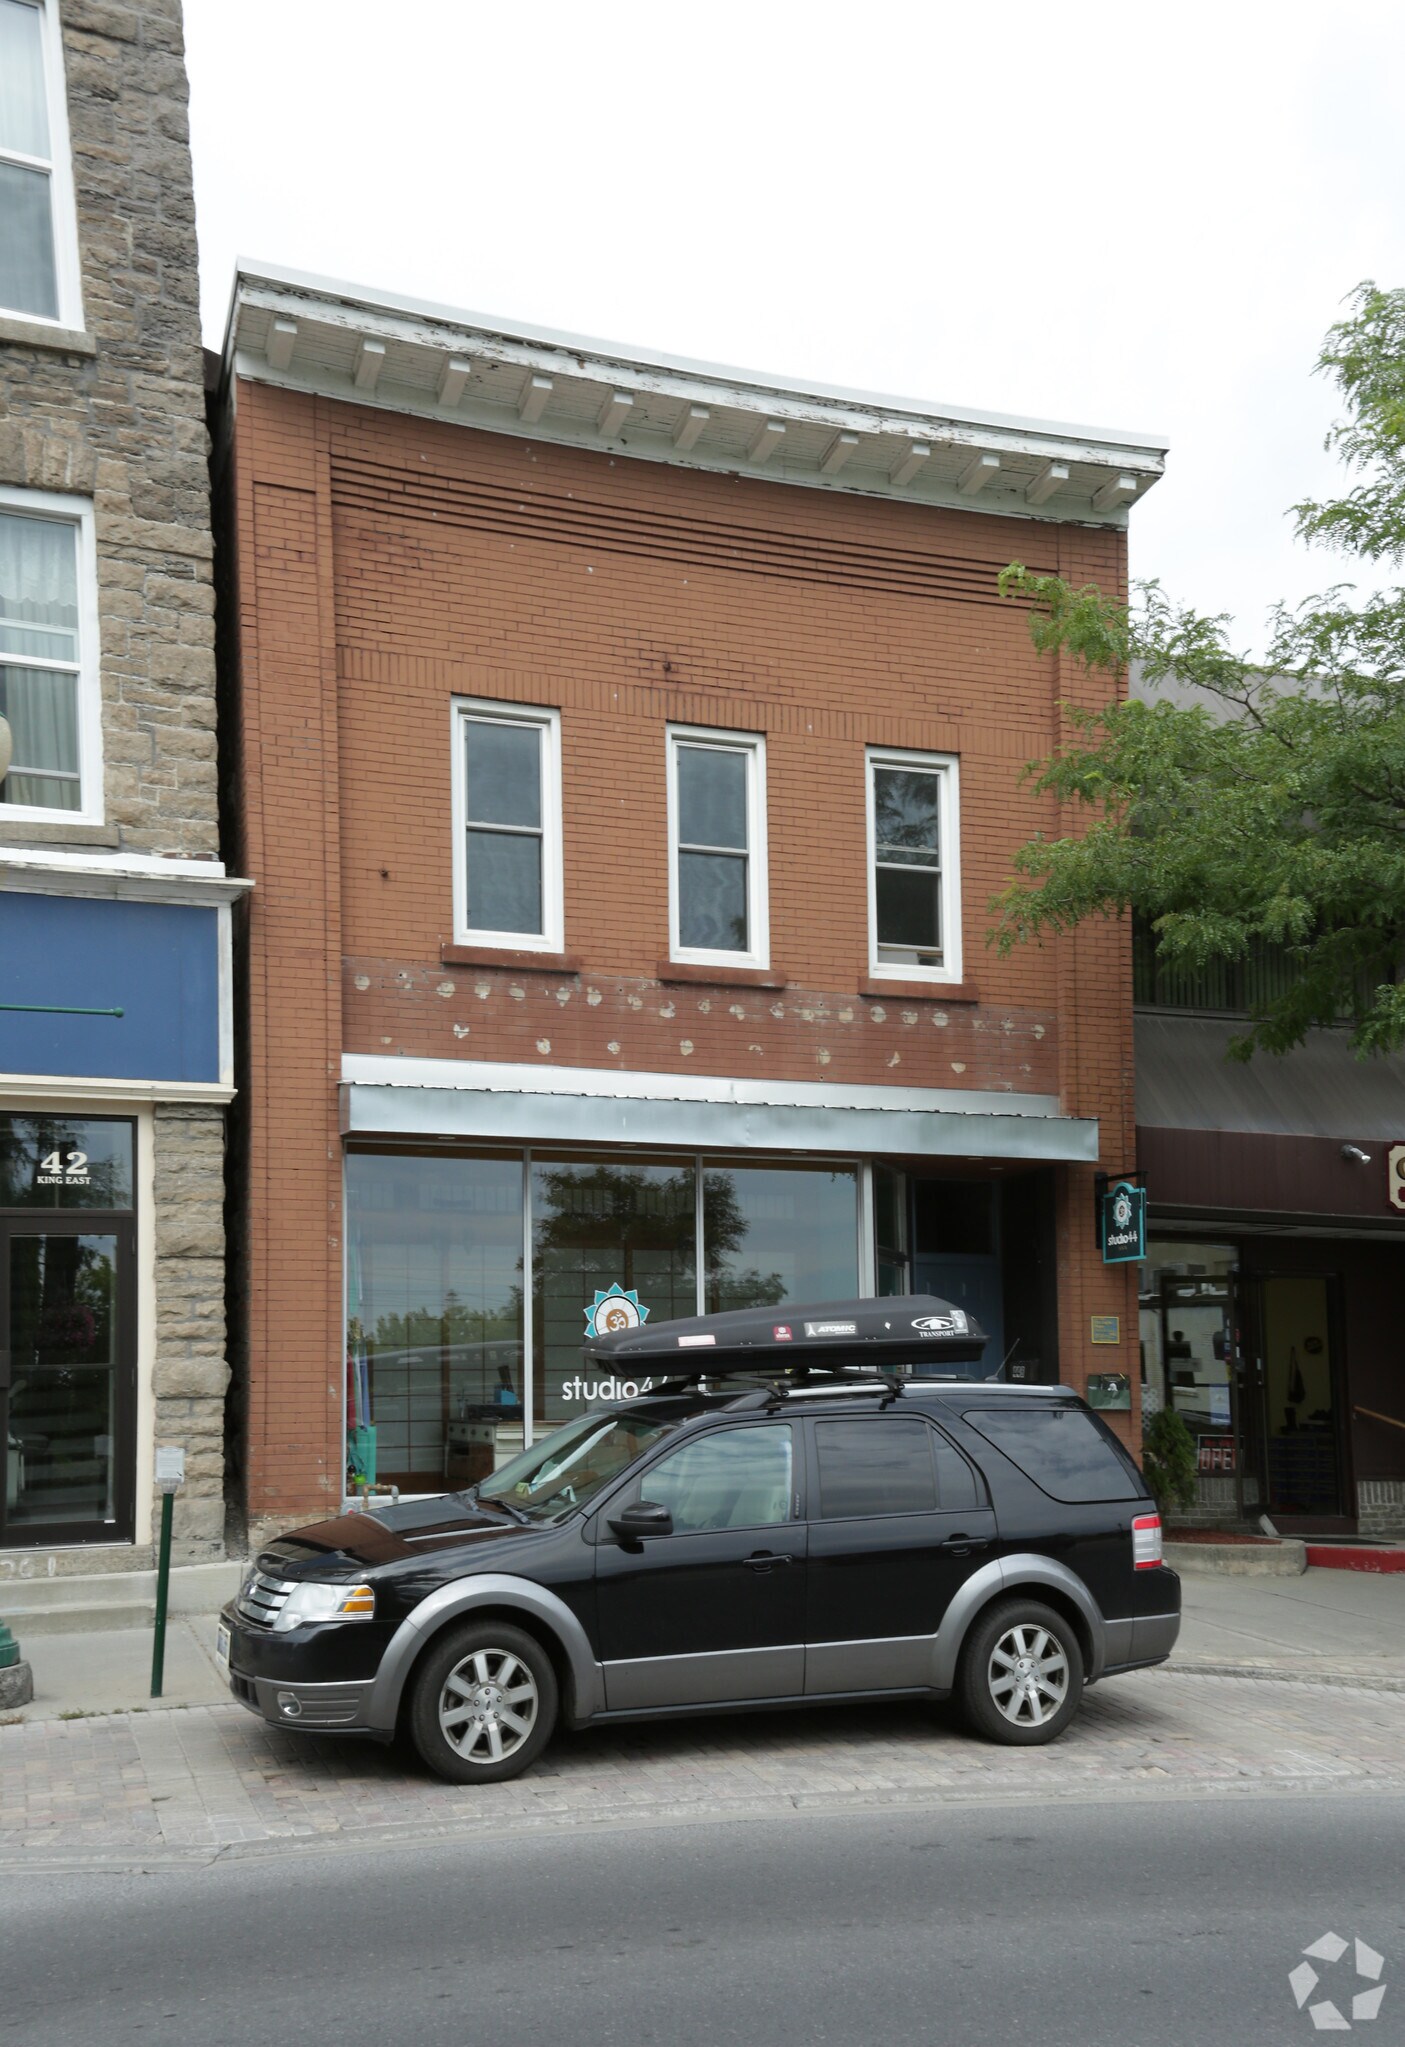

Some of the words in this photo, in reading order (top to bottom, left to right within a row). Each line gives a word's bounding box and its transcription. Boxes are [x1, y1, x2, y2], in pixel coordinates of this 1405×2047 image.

[40, 1151, 88, 1175] 42
[37, 1175, 63, 1184] KING
[65, 1176, 92, 1185] EAST
[817, 1324, 856, 1333] ATOMIC
[919, 1330, 955, 1338] TRANSPORT
